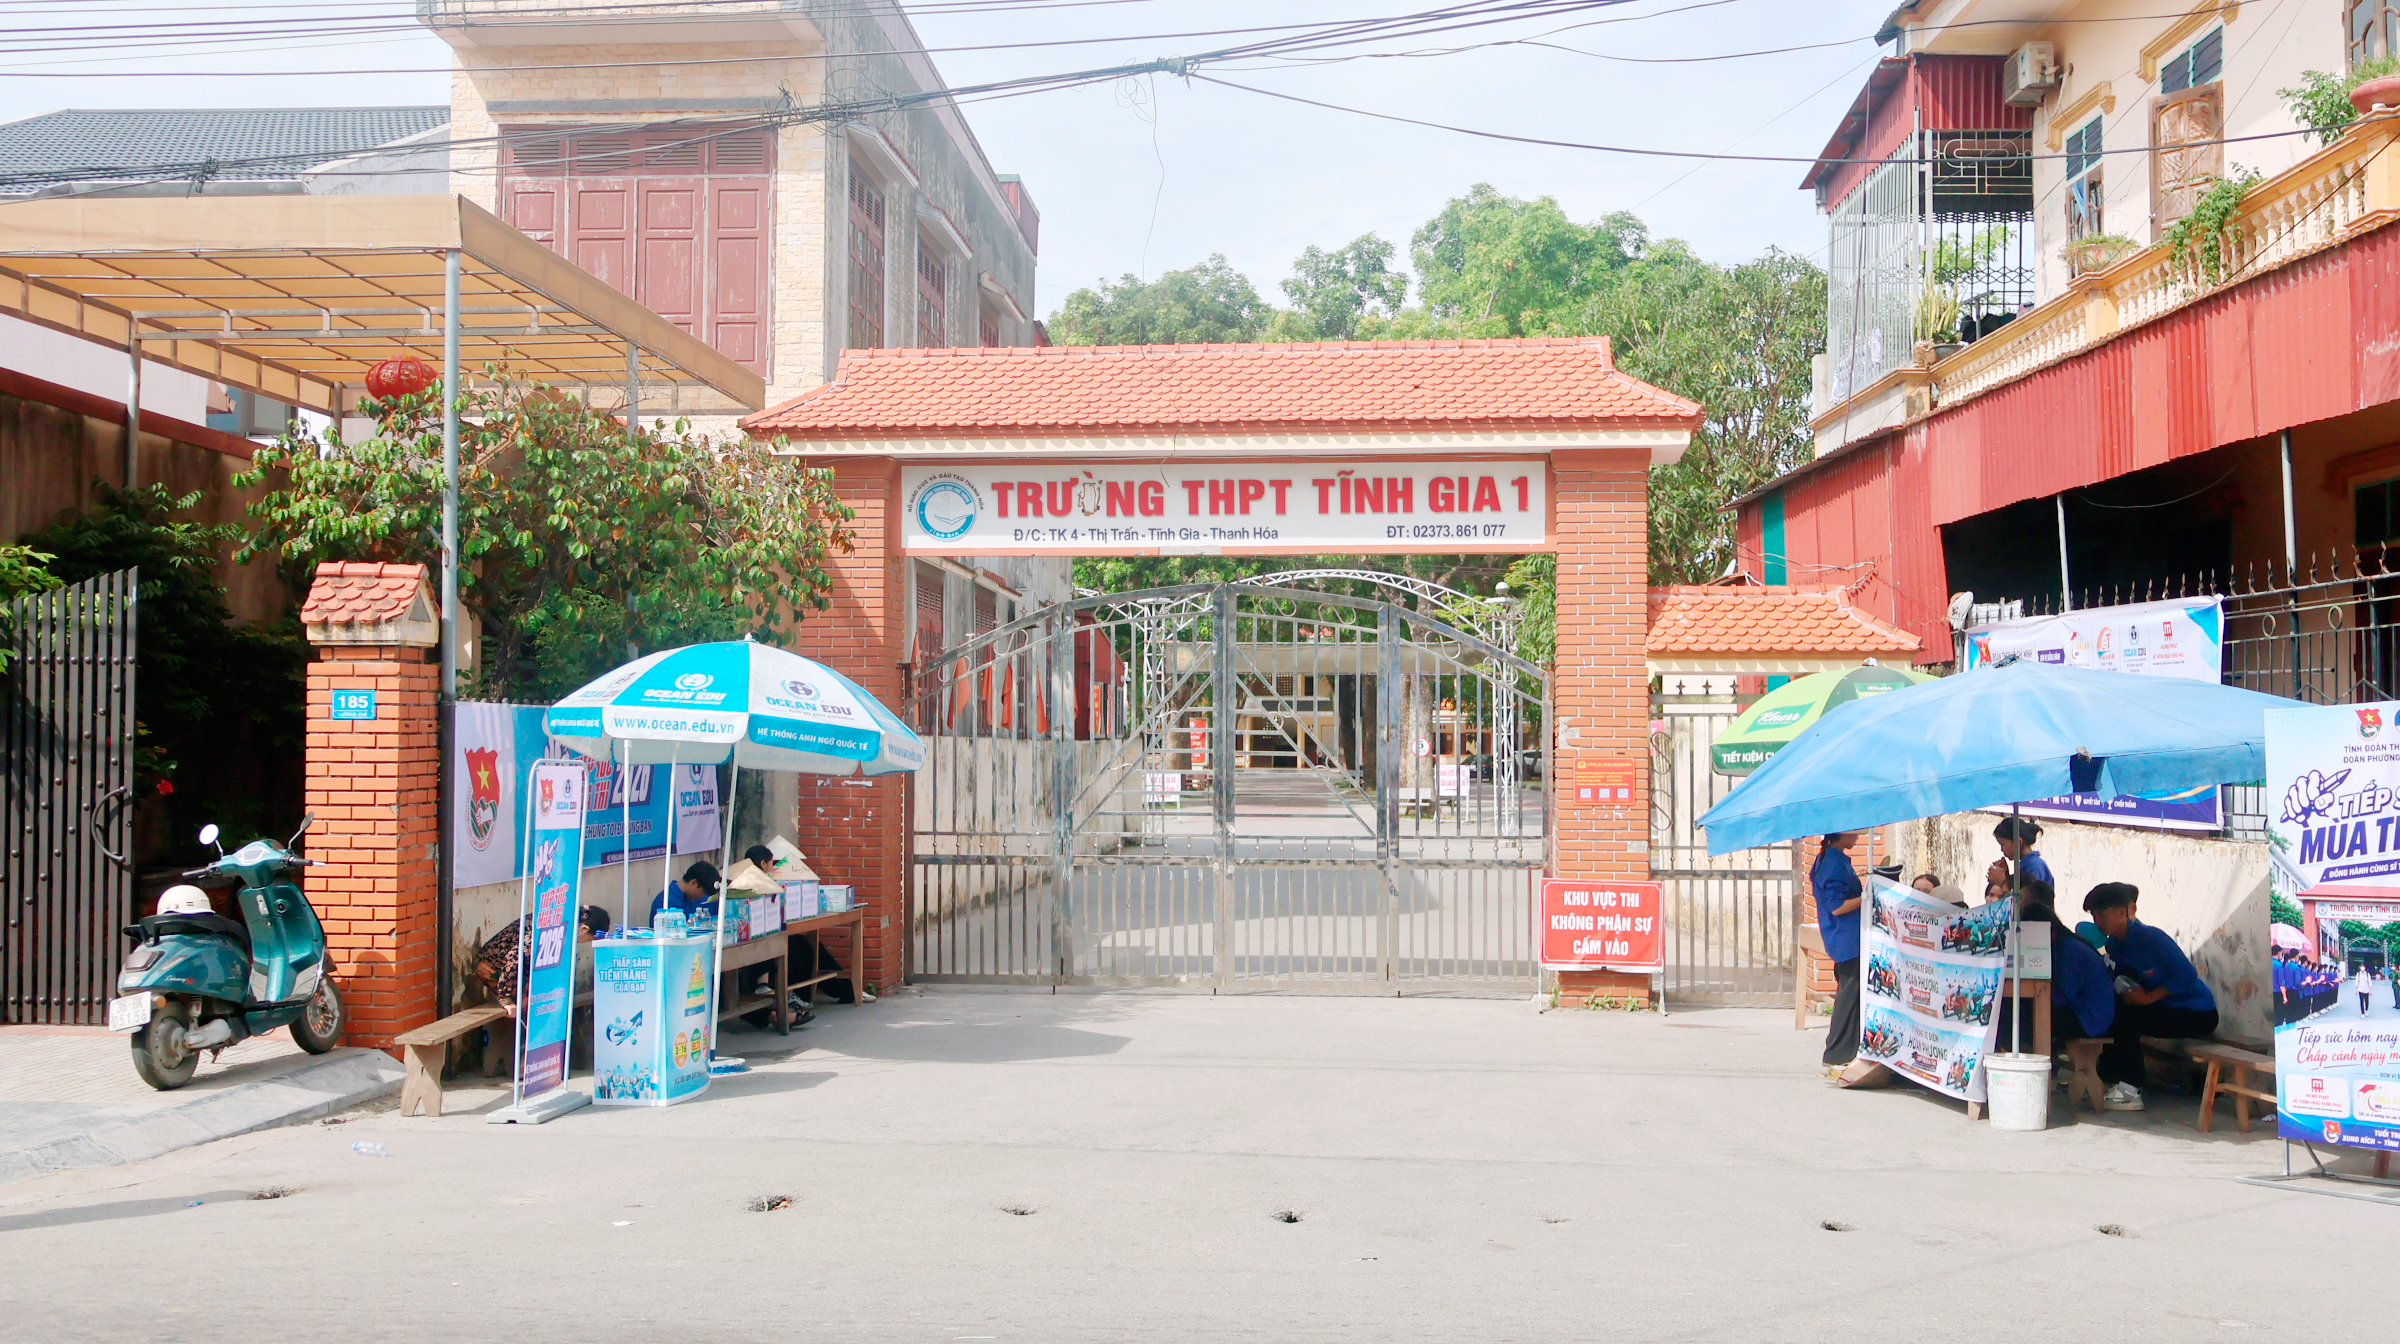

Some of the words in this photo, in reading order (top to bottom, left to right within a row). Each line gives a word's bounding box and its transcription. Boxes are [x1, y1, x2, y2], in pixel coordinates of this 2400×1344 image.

[1181, 479, 1292, 516] THPT
[1312, 469, 1413, 515] TĨNH
[1428, 476, 1501, 513] GIA
[1511, 476, 1529, 512] 1
[1013, 528, 1046, 542] Đ/C:
[1049, 529, 1067, 541] TK
[1070, 528, 1078, 541] 4
[1088, 528, 1107, 543] Thị
[1110, 527, 1139, 541] Trấn
[1148, 527, 1176, 540] Tĩnh
[1179, 527, 1200, 540] Gia
[1210, 527, 1249, 540] Thanh
[1253, 526, 1278, 540] Hóa
[1386, 526, 1410, 538] ĐT:
[1483, 524, 1506, 537] 077
[338, 695, 369, 708] 185
[644, 688, 694, 700] OCEAN
[694, 691, 727, 701] EDU
[766, 696, 818, 711] OCEAN
[821, 704, 852, 716] EDU
[1757, 711, 1800, 723] Knorr
[614, 717, 735, 734] www.ocean.edu.vn
[757, 727, 769, 737] HỆ
[769, 729, 797, 740] THỐNG
[798, 733, 816, 743] ANH
[817, 736, 836, 746] NGỮ
[836, 739, 857, 749] QUỐC
[858, 742, 869, 751] TẾ
[2344, 744, 2362, 753] TỈNH
[2364, 743, 2387, 752] ĐOÀN
[1722, 750, 1742, 764] TIẾT
[1742, 751, 1764, 765] KIỆM
[2343, 755, 2365, 764] ĐOÀN
[680, 791, 701, 807] OCEAN
[702, 789, 714, 806] EDU
[2338, 779, 2393, 820] TIẾP
[2298, 817, 2368, 865] MÙA
[2329, 866, 2348, 878] ĐỒNG
[2349, 864, 2368, 876] HÀNH
[2369, 862, 2389, 874] CÙNG
[1563, 890, 1589, 906] KHU
[1591, 889, 1617, 911] VỰC
[1620, 892, 1640, 907] THI
[2330, 903, 2355, 912] TRƯỜNG
[2358, 905, 2373, 913] THPT
[1551, 912, 1593, 931] KHÔNG
[1596, 913, 1631, 932] PHẬN
[1634, 915, 1653, 936] SỰ
[535, 925, 565, 968] 2026
[1572, 936, 1601, 955] CẤM
[1604, 937, 1629, 956] VÀO
[2280, 940, 2300, 948] VISSAN
[632, 955, 652, 968] SÁNG
[621, 967, 647, 982] NĂNG
[630, 982, 646, 994] BẠN
[2296, 1026, 2321, 1048] Tiếp
[2324, 1031, 2343, 1043] sức
[2346, 1028, 2372, 1043] hôm
[2375, 1034, 2399, 1049] nay
[2297, 1046, 2328, 1068] Chắp
[2331, 1047, 2358, 1062] cánh
[2360, 1049, 2386, 1067] ngày
[2342, 1134, 2359, 1143] XUNG
[2359, 1133, 2375, 1145] KÍCH
[2374, 1129, 2390, 1138] TUỔI
